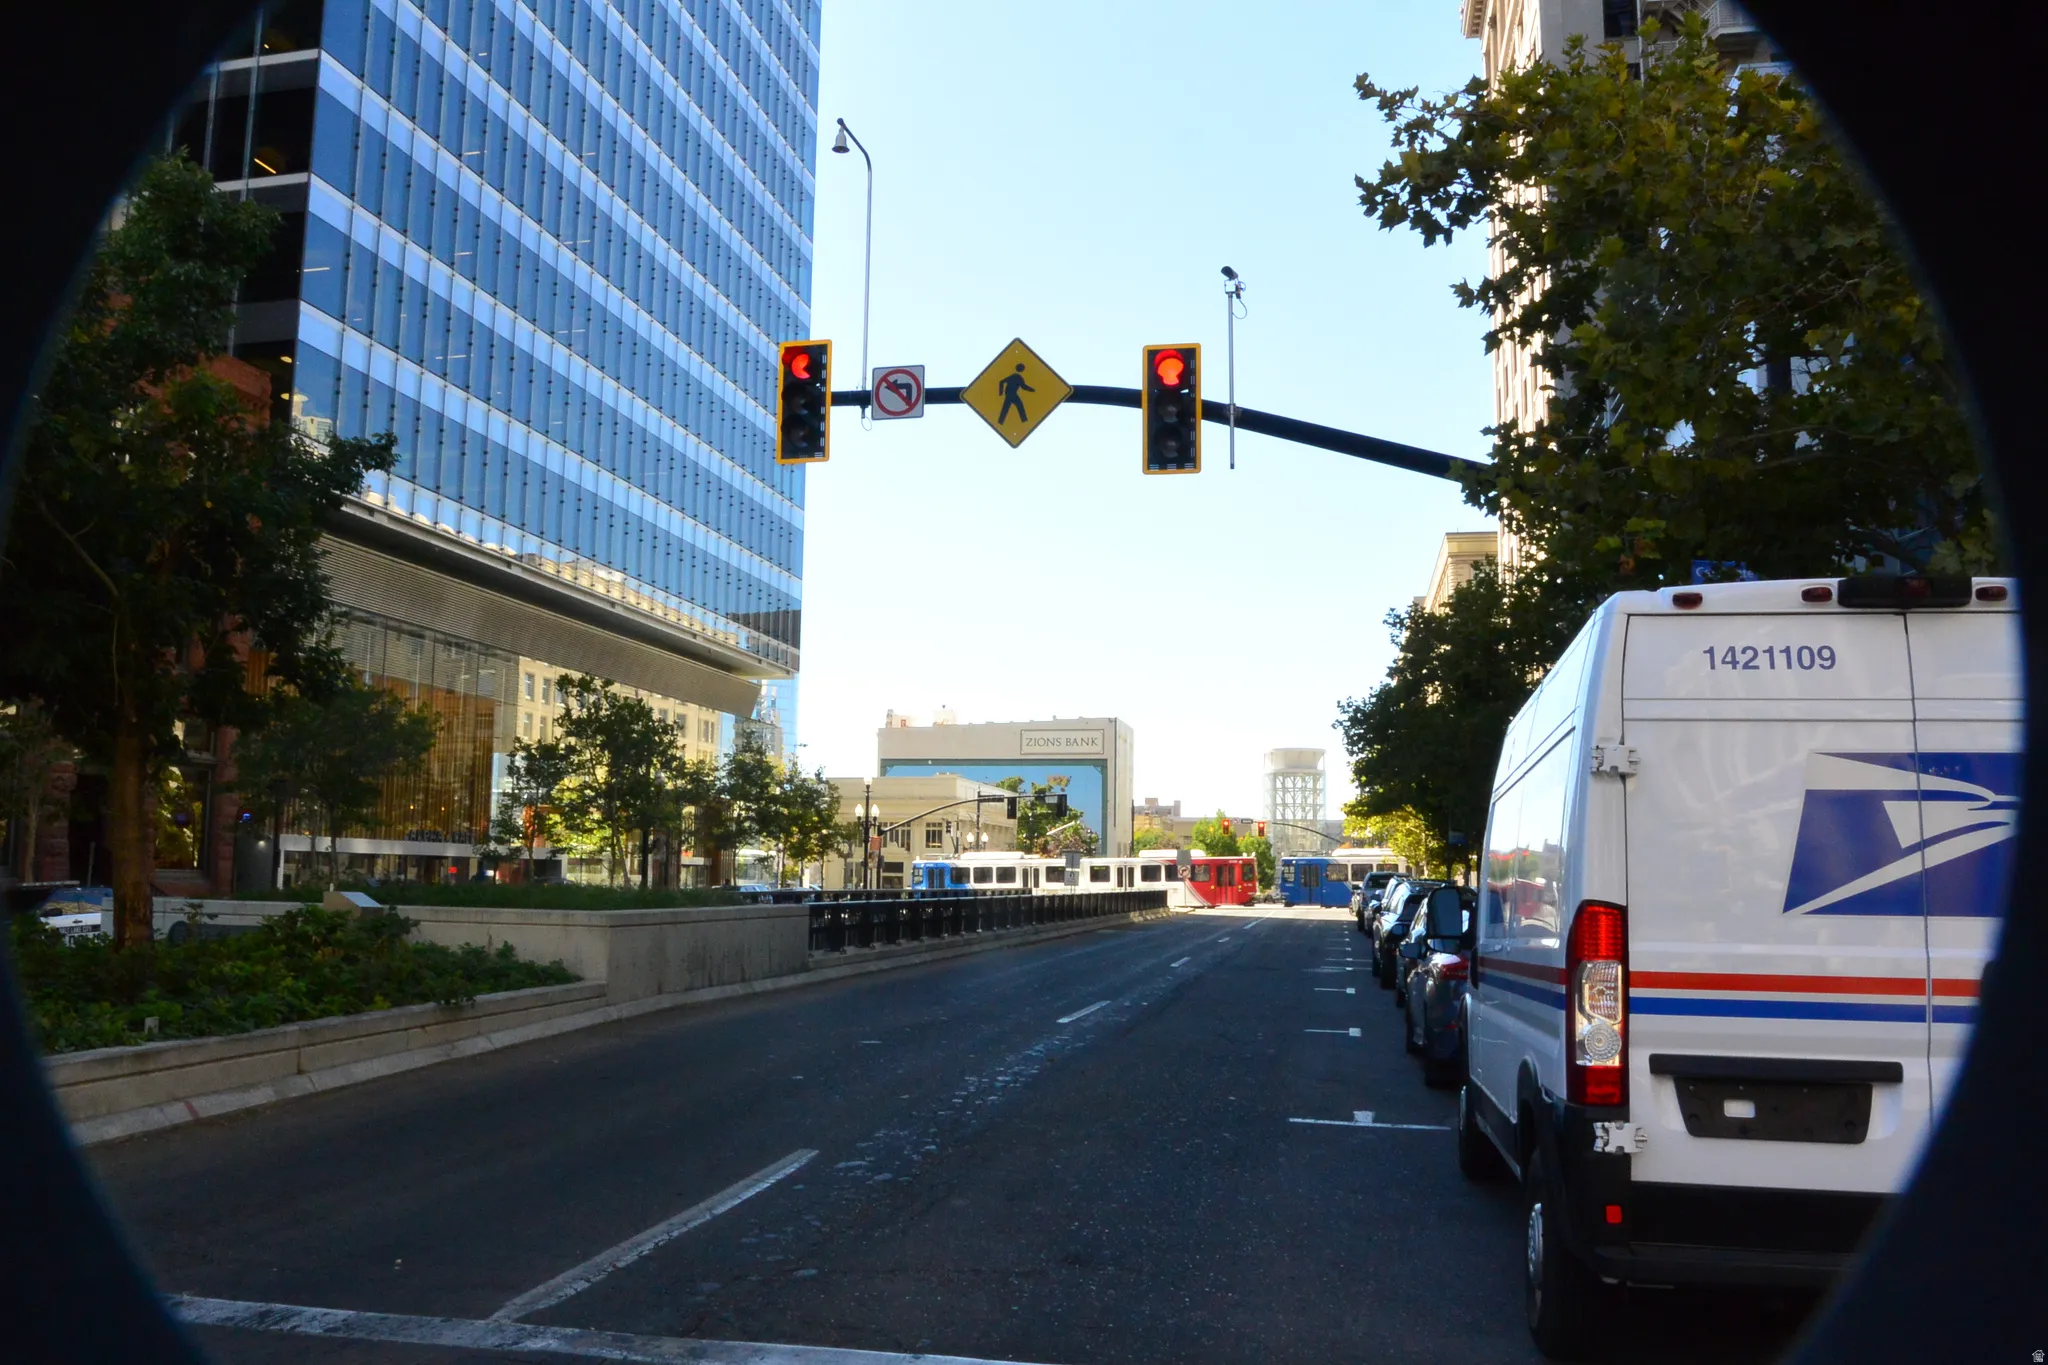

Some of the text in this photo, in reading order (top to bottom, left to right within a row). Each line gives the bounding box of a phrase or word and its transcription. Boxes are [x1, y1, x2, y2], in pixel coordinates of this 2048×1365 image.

[1703, 645, 1836, 671] 1421109
[1025, 737, 1099, 747] ZIONS BANK
